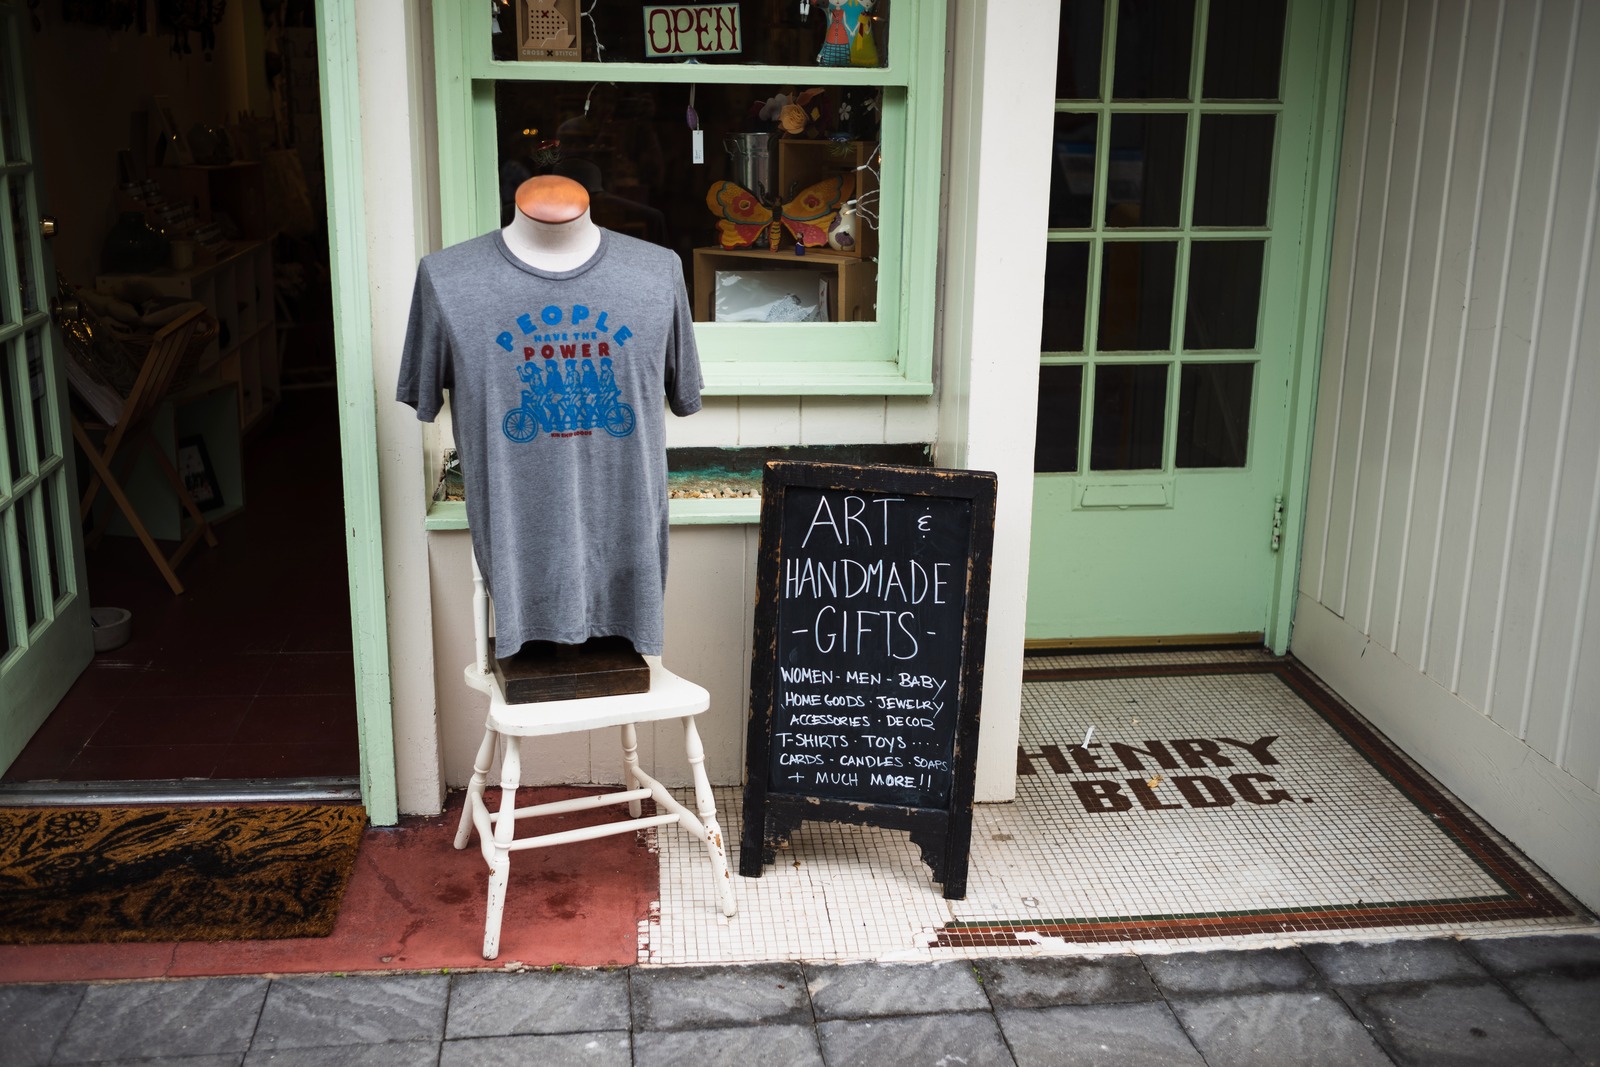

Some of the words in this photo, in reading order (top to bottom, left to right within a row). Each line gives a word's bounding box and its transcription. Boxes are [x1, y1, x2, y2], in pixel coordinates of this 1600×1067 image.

[648, 7, 738, 54] OPEN
[496, 304, 633, 352] PEOPLE
[534, 333, 568, 342] HAVE
[573, 331, 597, 341] THE
[524, 342, 610, 361] POWER
[802, 495, 905, 548] ART
[786, 558, 950, 604] HANDMADE
[846, 671, 881, 685] MEN
[899, 672, 946, 700] BABY
[876, 696, 944, 719] JEWELRY
[790, 714, 870, 727] ACCESSORIES
[886, 715, 935, 730] DECOR
[776, 733, 848, 748] T-SHIRTS
[779, 753, 824, 766] CARDS
[840, 755, 904, 768] CANDLES
[913, 756, 948, 771] SOAPS
[1017, 735, 1280, 775] HENRY
[815, 772, 858, 786] MUCH
[1069, 772, 1314, 813] BLDG.
